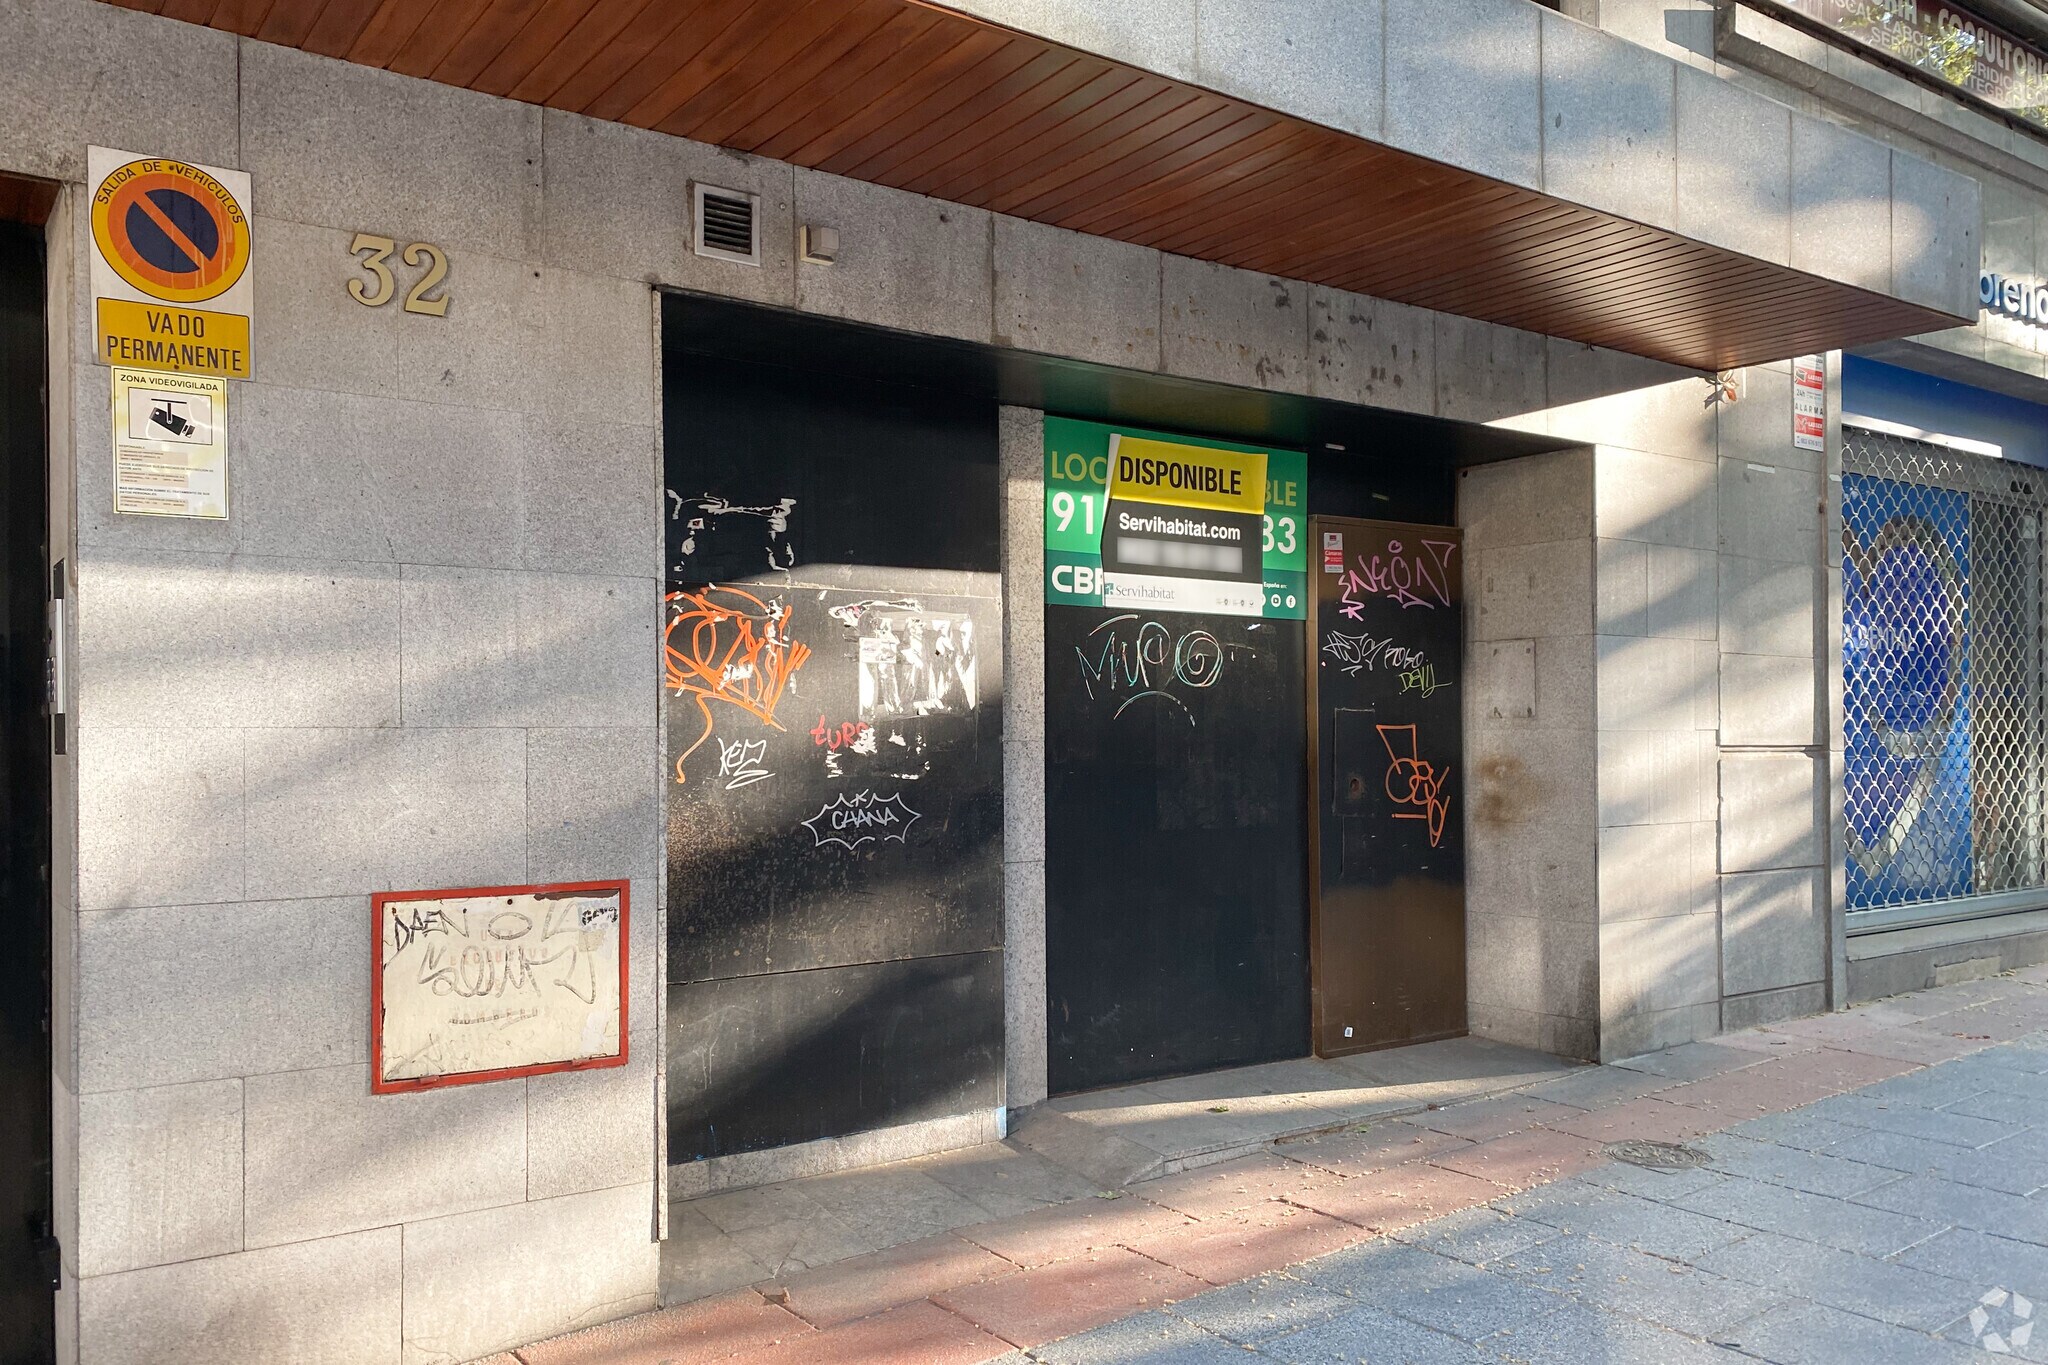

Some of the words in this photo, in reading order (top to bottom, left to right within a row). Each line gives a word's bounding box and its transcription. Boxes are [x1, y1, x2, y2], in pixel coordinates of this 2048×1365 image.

[97, 167, 136, 205] SALIDA
[142, 161, 163, 173] DE
[175, 163, 243, 224] VEHICULOS
[347, 232, 452, 318] 32
[146, 310, 205, 338] VADO
[106, 335, 243, 372] PERMANENTE
[120, 374, 147, 385] ZONA
[148, 376, 219, 392] VIDEOVIGILADA
[1794, 402, 1823, 415] ALARMA
[1119, 455, 1242, 496] DISPONIBLE
[1052, 491, 1094, 535] 91
[1119, 512, 1241, 541] Servihabitat.com
[1115, 584, 1176, 601] Servihabitat
[831, 806, 900, 830] CHANA
